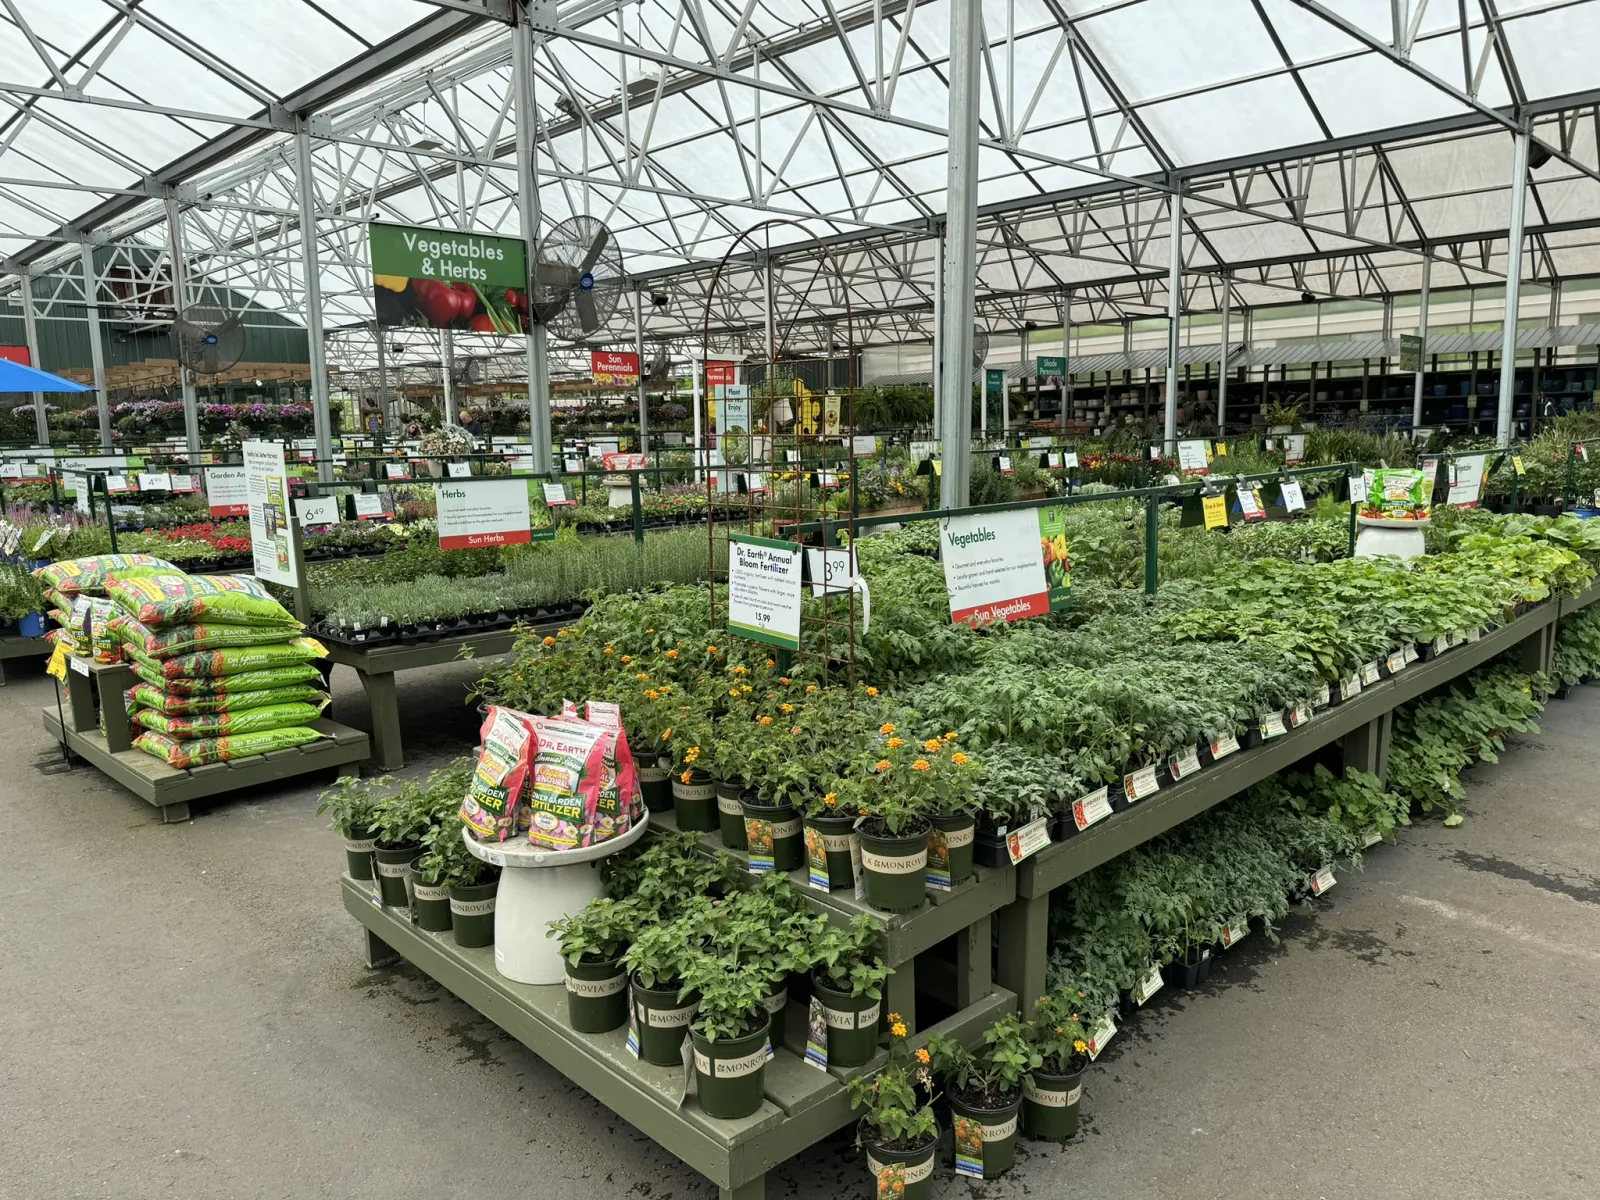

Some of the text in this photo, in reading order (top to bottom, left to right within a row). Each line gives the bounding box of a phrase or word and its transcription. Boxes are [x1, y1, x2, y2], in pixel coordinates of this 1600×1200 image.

[403, 232, 504, 261] Vegetables
[422, 258, 487, 280] & Herbs
[608, 354, 622, 363] Sun
[1044, 358, 1057, 367] Shade
[597, 362, 633, 372] Perennials
[1040, 368, 1062, 376] Perennials
[728, 404, 742, 412] Enjoy
[442, 488, 466, 498] Herbs
[468, 534, 504, 544] Sun Herbs
[948, 526, 996, 548] Vegetables
[737, 547, 746, 556] Dr.
[768, 553, 792, 564] Annual
[740, 558, 789, 574] Bloom Fertilizer
[220, 608, 244, 616] EARTH
[974, 600, 1031, 620] Sun Vegetables
[756, 612, 770, 622] 15.99
[246, 736, 272, 744] EARTH
[556, 743, 586, 755] EARTH
[536, 752, 581, 771] Annual Bloom
[540, 765, 570, 780] Organic
[541, 776, 569, 788] NATURAL
[548, 797, 581, 806] GARDEN
[531, 800, 581, 818] ERTILIZER
[571, 984, 605, 993] NROVIA
